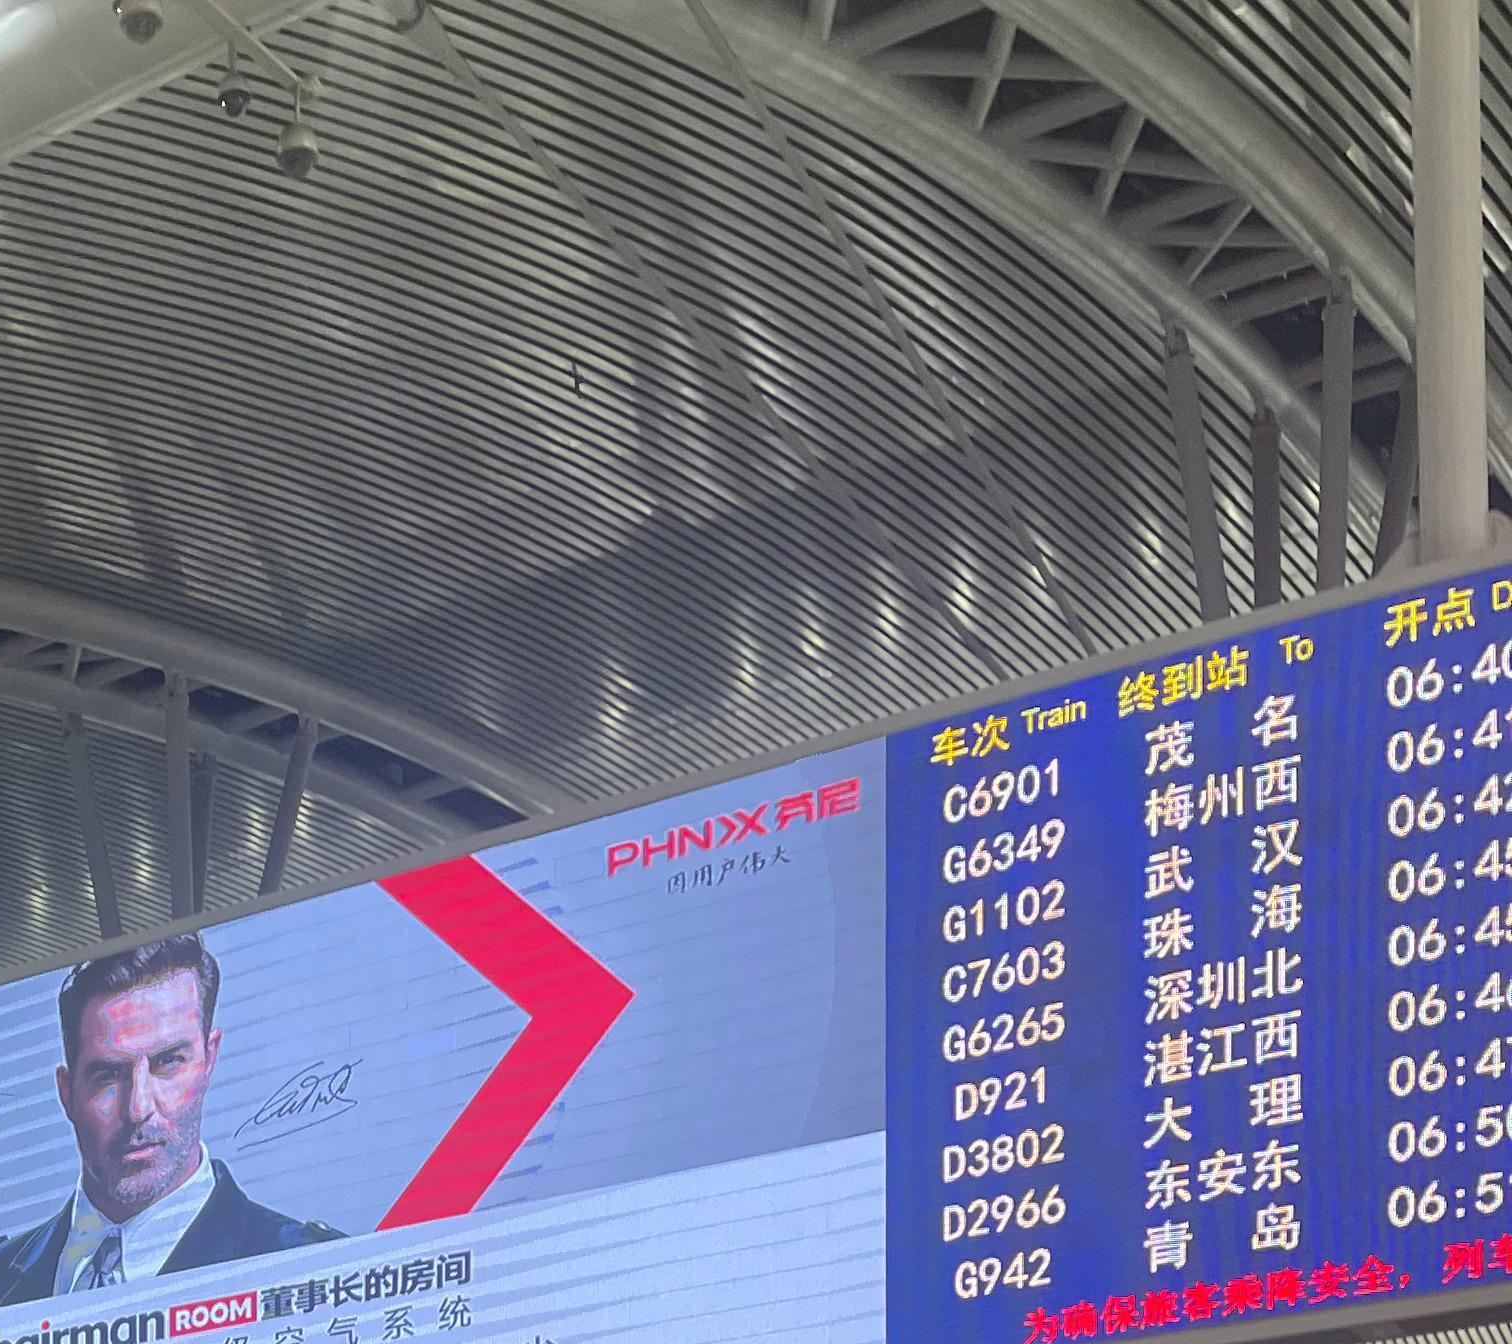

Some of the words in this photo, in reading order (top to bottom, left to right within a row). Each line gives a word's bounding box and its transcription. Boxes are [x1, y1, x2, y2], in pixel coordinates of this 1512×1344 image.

[930, 714, 1011, 767] 车次
[1020, 698, 1087, 734] Train
[1117, 644, 1250, 718] 终到站
[1278, 634, 1314, 665] To
[1383, 586, 1476, 648] 开点
[942, 818, 1066, 884] G6349
[1144, 754, 1302, 838] 梅州西
[943, 757, 1059, 823] C6901
[942, 878, 1066, 943] G1102
[942, 940, 1066, 1003] C7603
[942, 1001, 1066, 1063] G6265
[1144, 946, 1304, 1025] 深圳北
[955, 1066, 1046, 1122] D921
[1143, 1009, 1302, 1087] 湛江西
[942, 1123, 1065, 1184] D3802
[942, 1184, 1067, 1242] D2966
[1144, 1139, 1302, 1210] 东安东
[173, 1297, 254, 1337] ROOM
[259, 1249, 473, 1322] 董事长的房间
[954, 1247, 1052, 1299] G942
